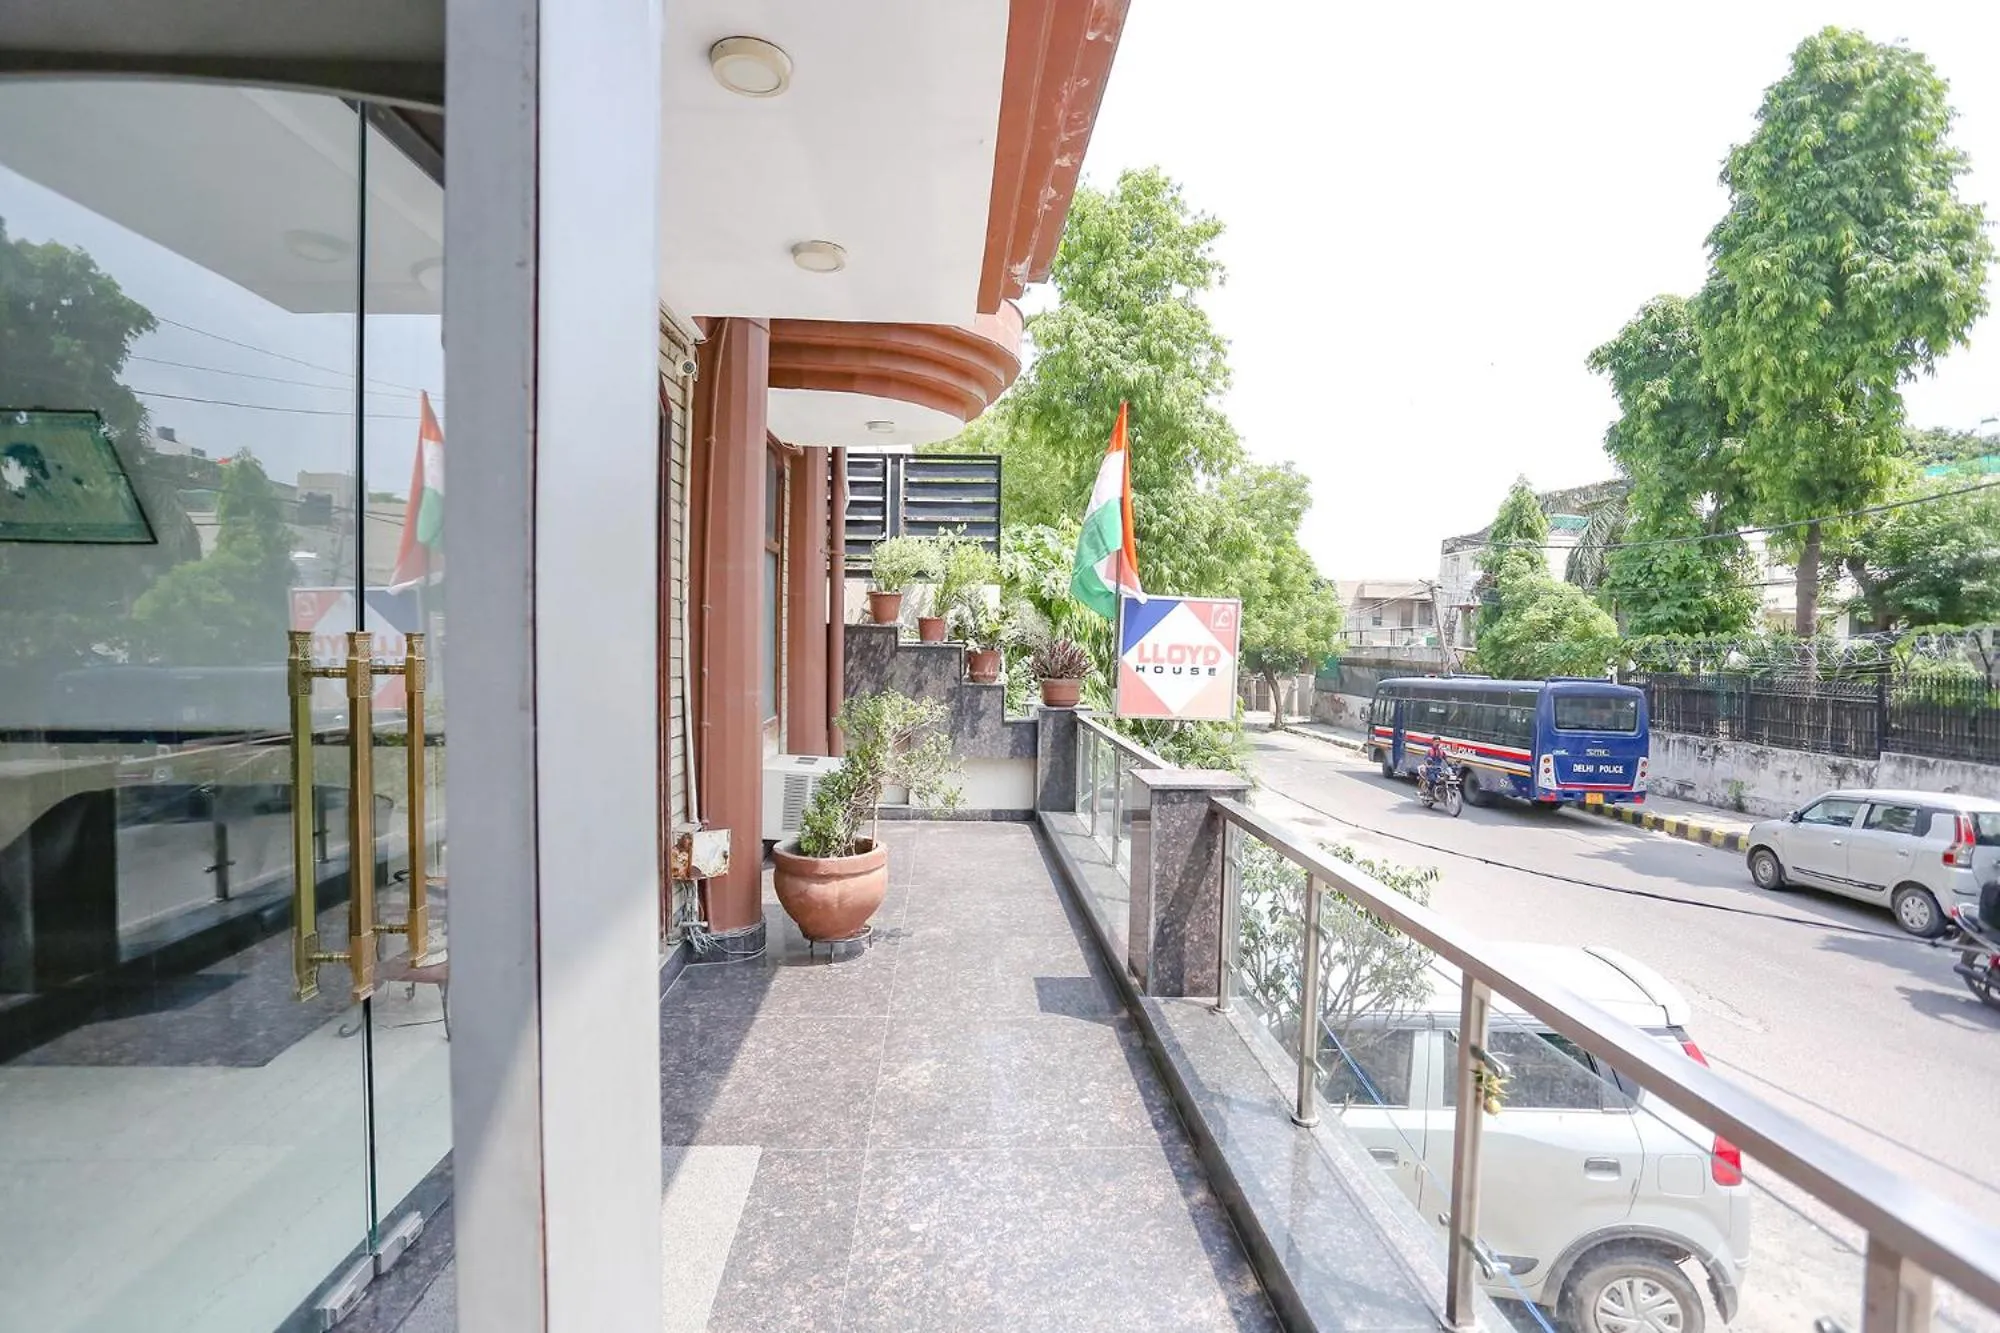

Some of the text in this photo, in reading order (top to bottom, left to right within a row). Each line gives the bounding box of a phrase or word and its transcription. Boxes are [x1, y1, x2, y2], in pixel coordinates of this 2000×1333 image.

[1137, 643, 1221, 665] LLOYD
[1136, 665, 1216, 676] HOUSE
[1573, 763, 1624, 774] DELHI POLICE
